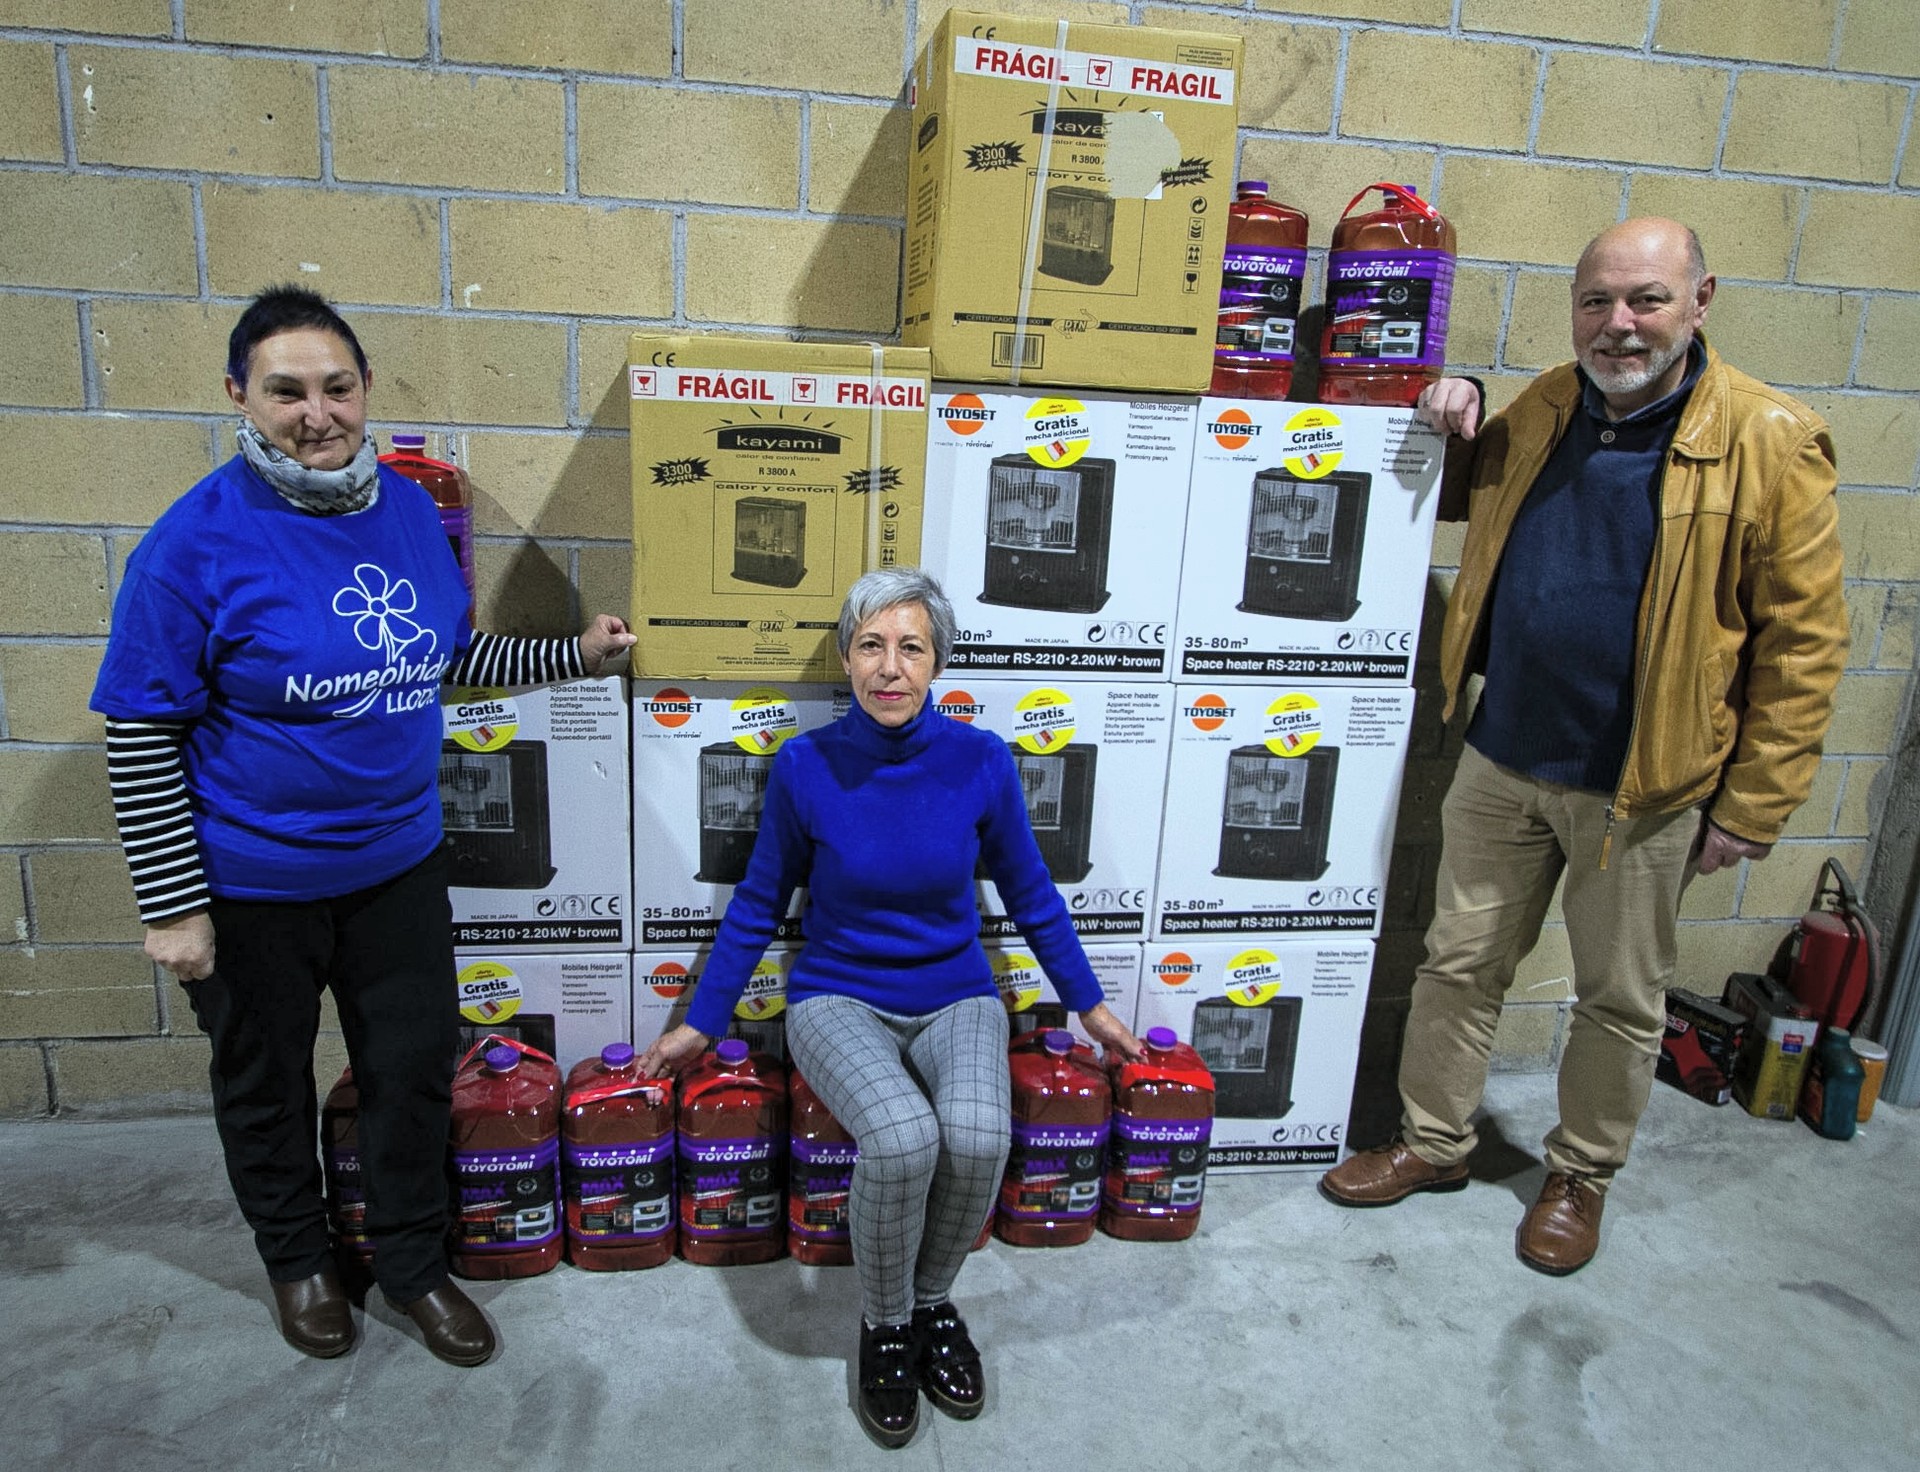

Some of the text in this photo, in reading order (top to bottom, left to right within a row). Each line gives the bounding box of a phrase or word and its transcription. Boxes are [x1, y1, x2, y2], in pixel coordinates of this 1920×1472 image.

[975, 48, 1221, 100] FRÁGIL FRÁGIL
[976, 147, 1006, 160] 3300
[1072, 154, 1100, 165] R 3800
[979, 157, 1012, 169] watts
[1223, 255, 1293, 274] TOYOTOMI
[1339, 260, 1413, 278] TOYOTOMI
[966, 314, 1014, 324] CERTIFICADO
[1064, 319, 1088, 330] DTN
[1108, 323, 1154, 333] CERTIFICADO
[678, 373, 925, 407] FRÁGIL FRÁGIL
[1130, 402, 1156, 410] Mobiles
[936, 407, 997, 421] TOYOSET
[1034, 415, 1078, 432] Gratis
[1207, 422, 1263, 436] TOYOSET
[1025, 432, 1052, 441] mecha
[1053, 427, 1089, 437] adicional
[1292, 428, 1333, 444] Gratis
[736, 435, 822, 450] kayami
[1309, 440, 1343, 449] adicional
[735, 453, 760, 461] calor
[662, 464, 692, 477] 3300
[665, 472, 699, 482] watts
[758, 466, 797, 477] R 3800 A
[715, 483, 836, 494] calor y confort
[660, 619, 709, 627] CERTIFICADO
[760, 621, 784, 630] DTN
[970, 653, 1011, 664] heater
[1186, 657, 1224, 671] Space
[1225, 658, 1264, 670] heater
[550, 685, 609, 694] Space heater
[1107, 692, 1160, 700] Space heater
[1352, 695, 1375, 703] Space
[457, 702, 504, 718] Gratis
[642, 702, 702, 713] TOYOSET
[740, 706, 785, 722] Gratis
[1023, 707, 1065, 722] Gratis
[1183, 707, 1236, 718] TOYOSET
[448, 718, 477, 727] mecha
[478, 713, 516, 723] adicional
[732, 723, 758, 731] mecha
[760, 716, 796, 727] adicional
[1014, 723, 1040, 731] mecha
[1041, 717, 1075, 727] adicional
[1273, 711, 1312, 726] Gratis
[1289, 722, 1321, 731] adicional
[1164, 918, 1200, 931] Space
[1202, 918, 1238, 929] heater
[647, 927, 717, 940] Space heat
[1152, 964, 1202, 974] TOYOSET
[1233, 964, 1271, 979] Gratis
[464, 979, 508, 994] Gratis
[746, 976, 777, 990] ratis
[484, 988, 520, 999] adicional
[1030, 1131, 1098, 1147] TOYOTOMI
[1132, 1126, 1200, 1141] TOYOTOMI
[580, 1147, 656, 1167] TOYOTOMI
[696, 1143, 770, 1161] TOYOTOMI
[809, 1149, 859, 1164] TOYOTO
[460, 1154, 536, 1172] TOYOTOMI
